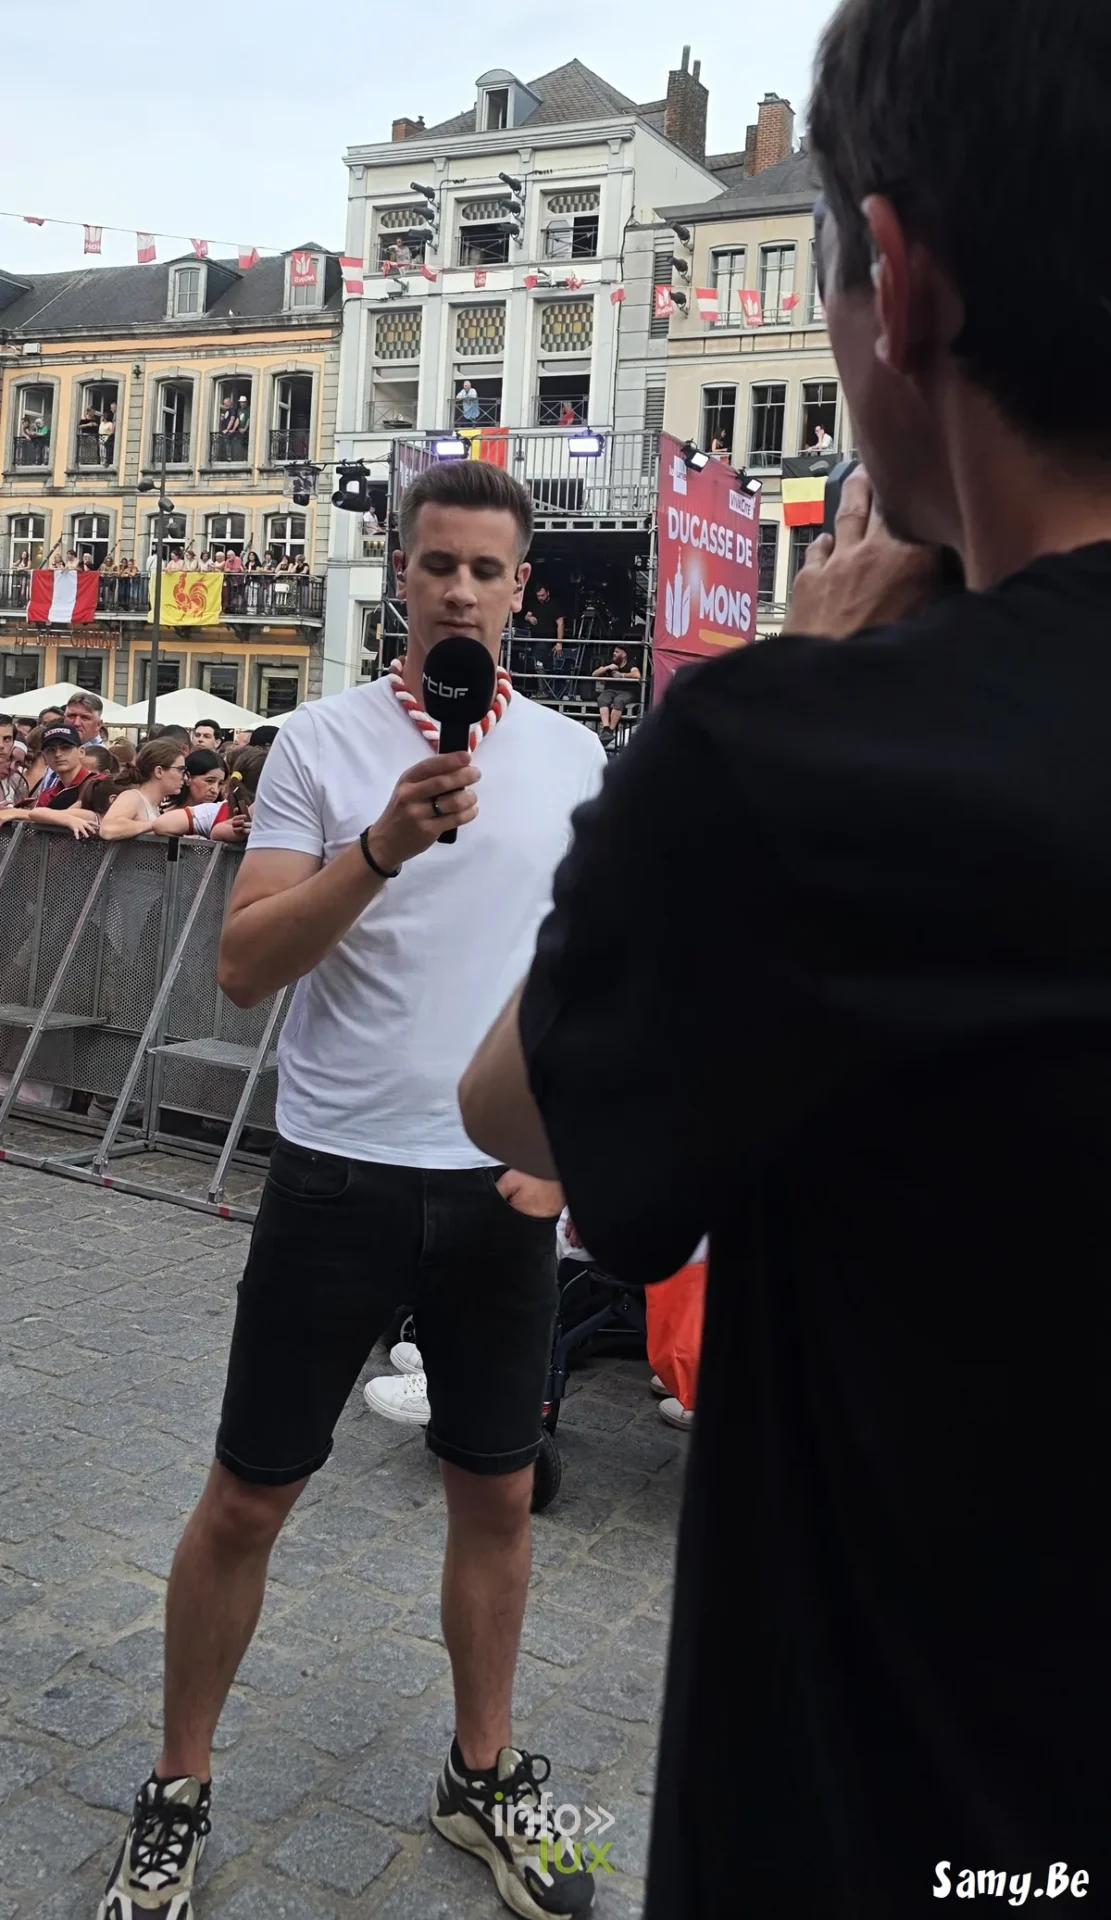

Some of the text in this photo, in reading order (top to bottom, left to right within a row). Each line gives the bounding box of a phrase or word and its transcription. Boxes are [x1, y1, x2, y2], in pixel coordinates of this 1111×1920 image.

[667, 506, 753, 568] DUCASSE DE
[700, 580, 751, 632] MONS
